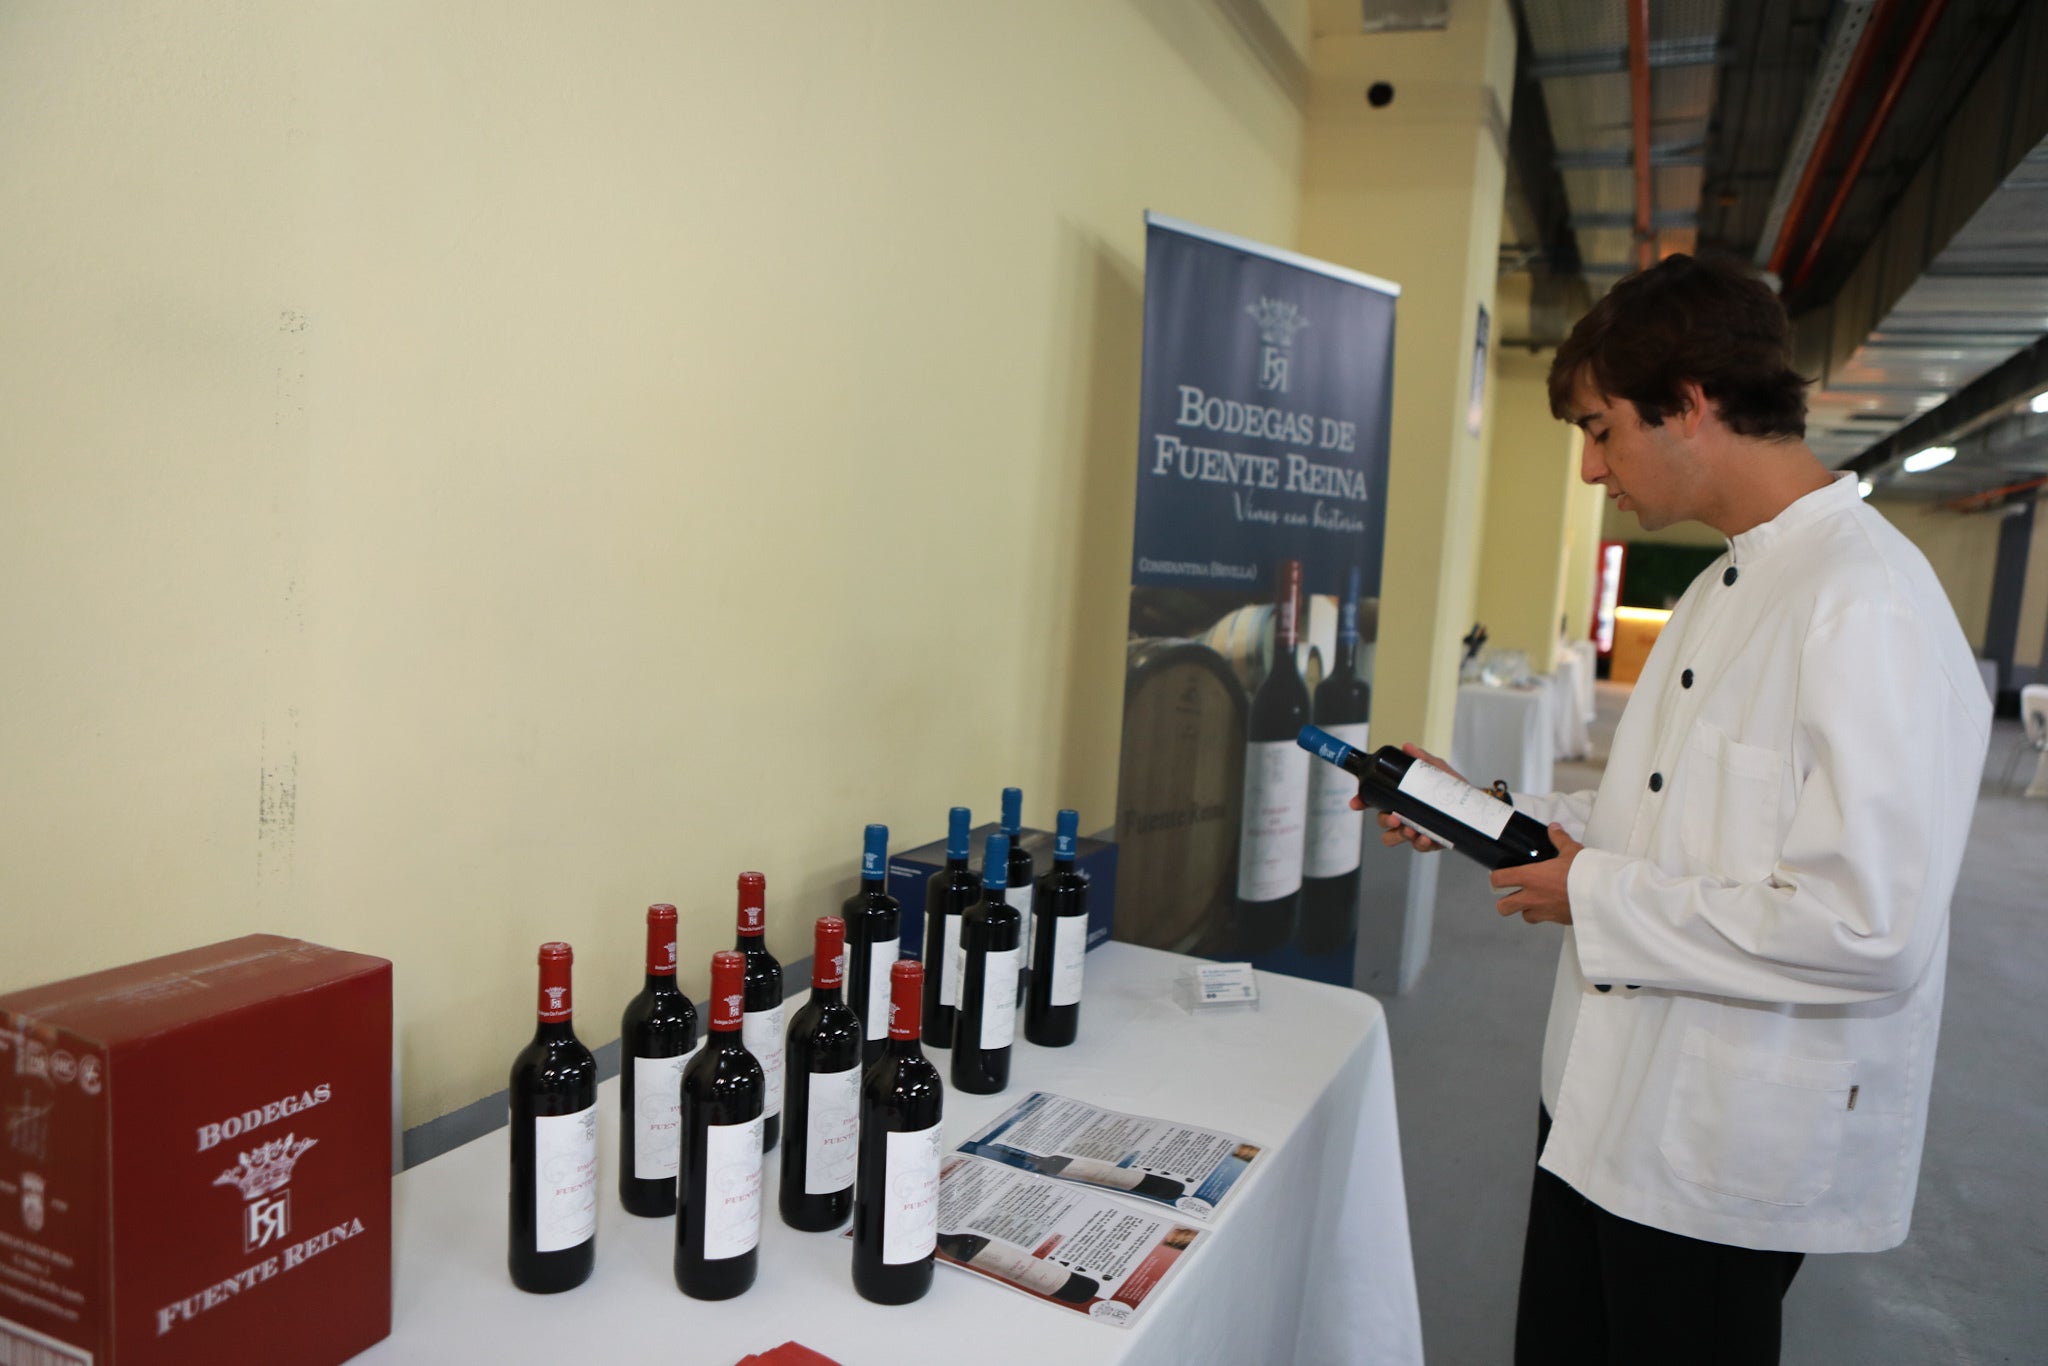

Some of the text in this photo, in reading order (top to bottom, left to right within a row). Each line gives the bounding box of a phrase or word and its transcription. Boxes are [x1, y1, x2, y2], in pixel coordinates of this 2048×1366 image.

[1176, 385, 1356, 453] BODEGAS DE
[1152, 433, 1368, 502] FUENTE REINA
[195, 1082, 332, 1153] BODEGAS
[154, 1257, 279, 1337] FUENTE
[282, 1216, 366, 1272] REINA
